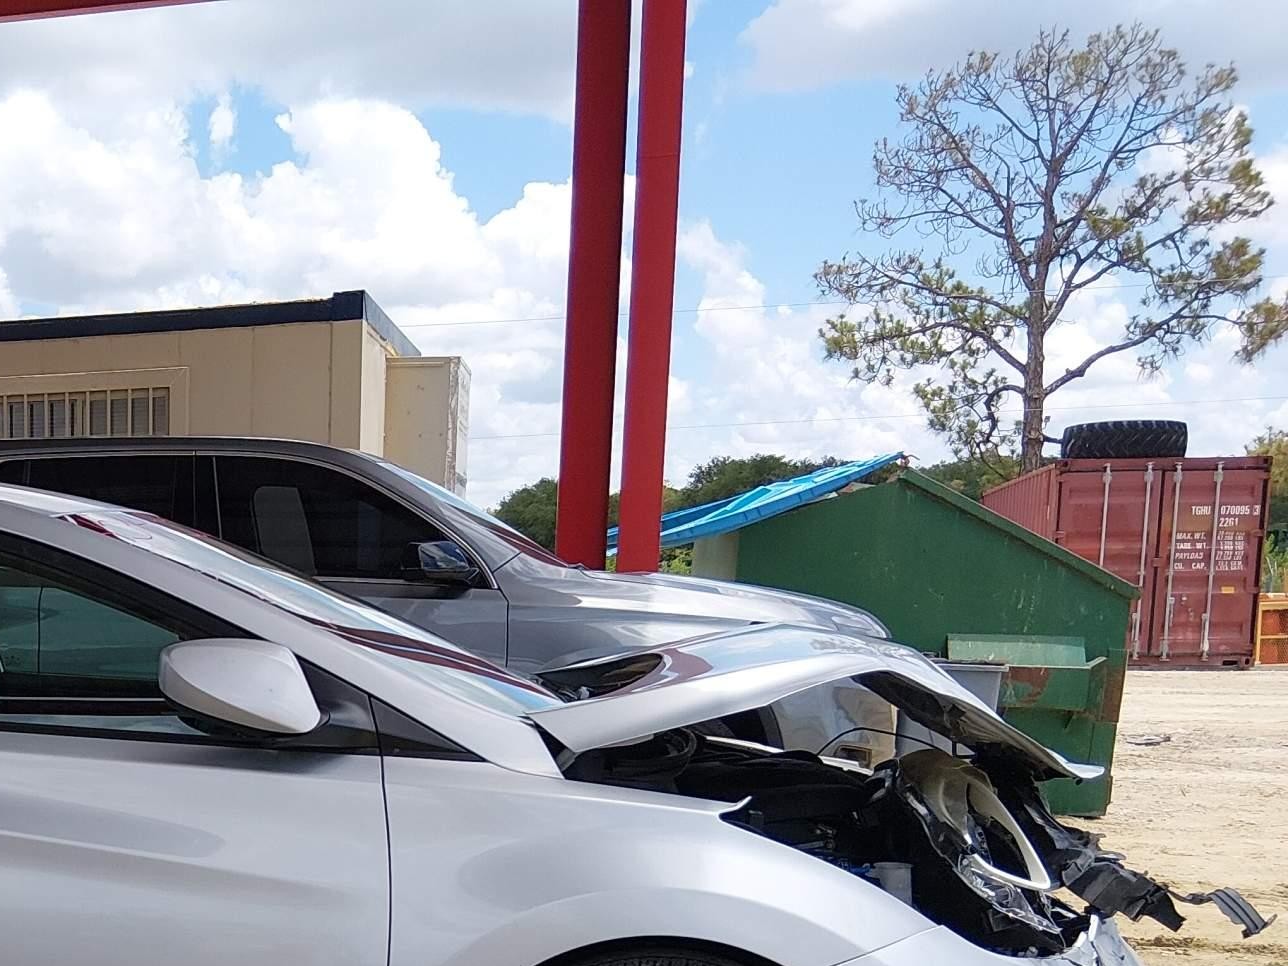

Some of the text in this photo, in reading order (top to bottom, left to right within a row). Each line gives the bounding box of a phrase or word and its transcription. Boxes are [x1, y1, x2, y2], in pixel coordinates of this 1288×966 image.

[1191, 505, 1261, 516] TGHU 070095 3
[1175, 552, 1204, 560] PAYLOAD
